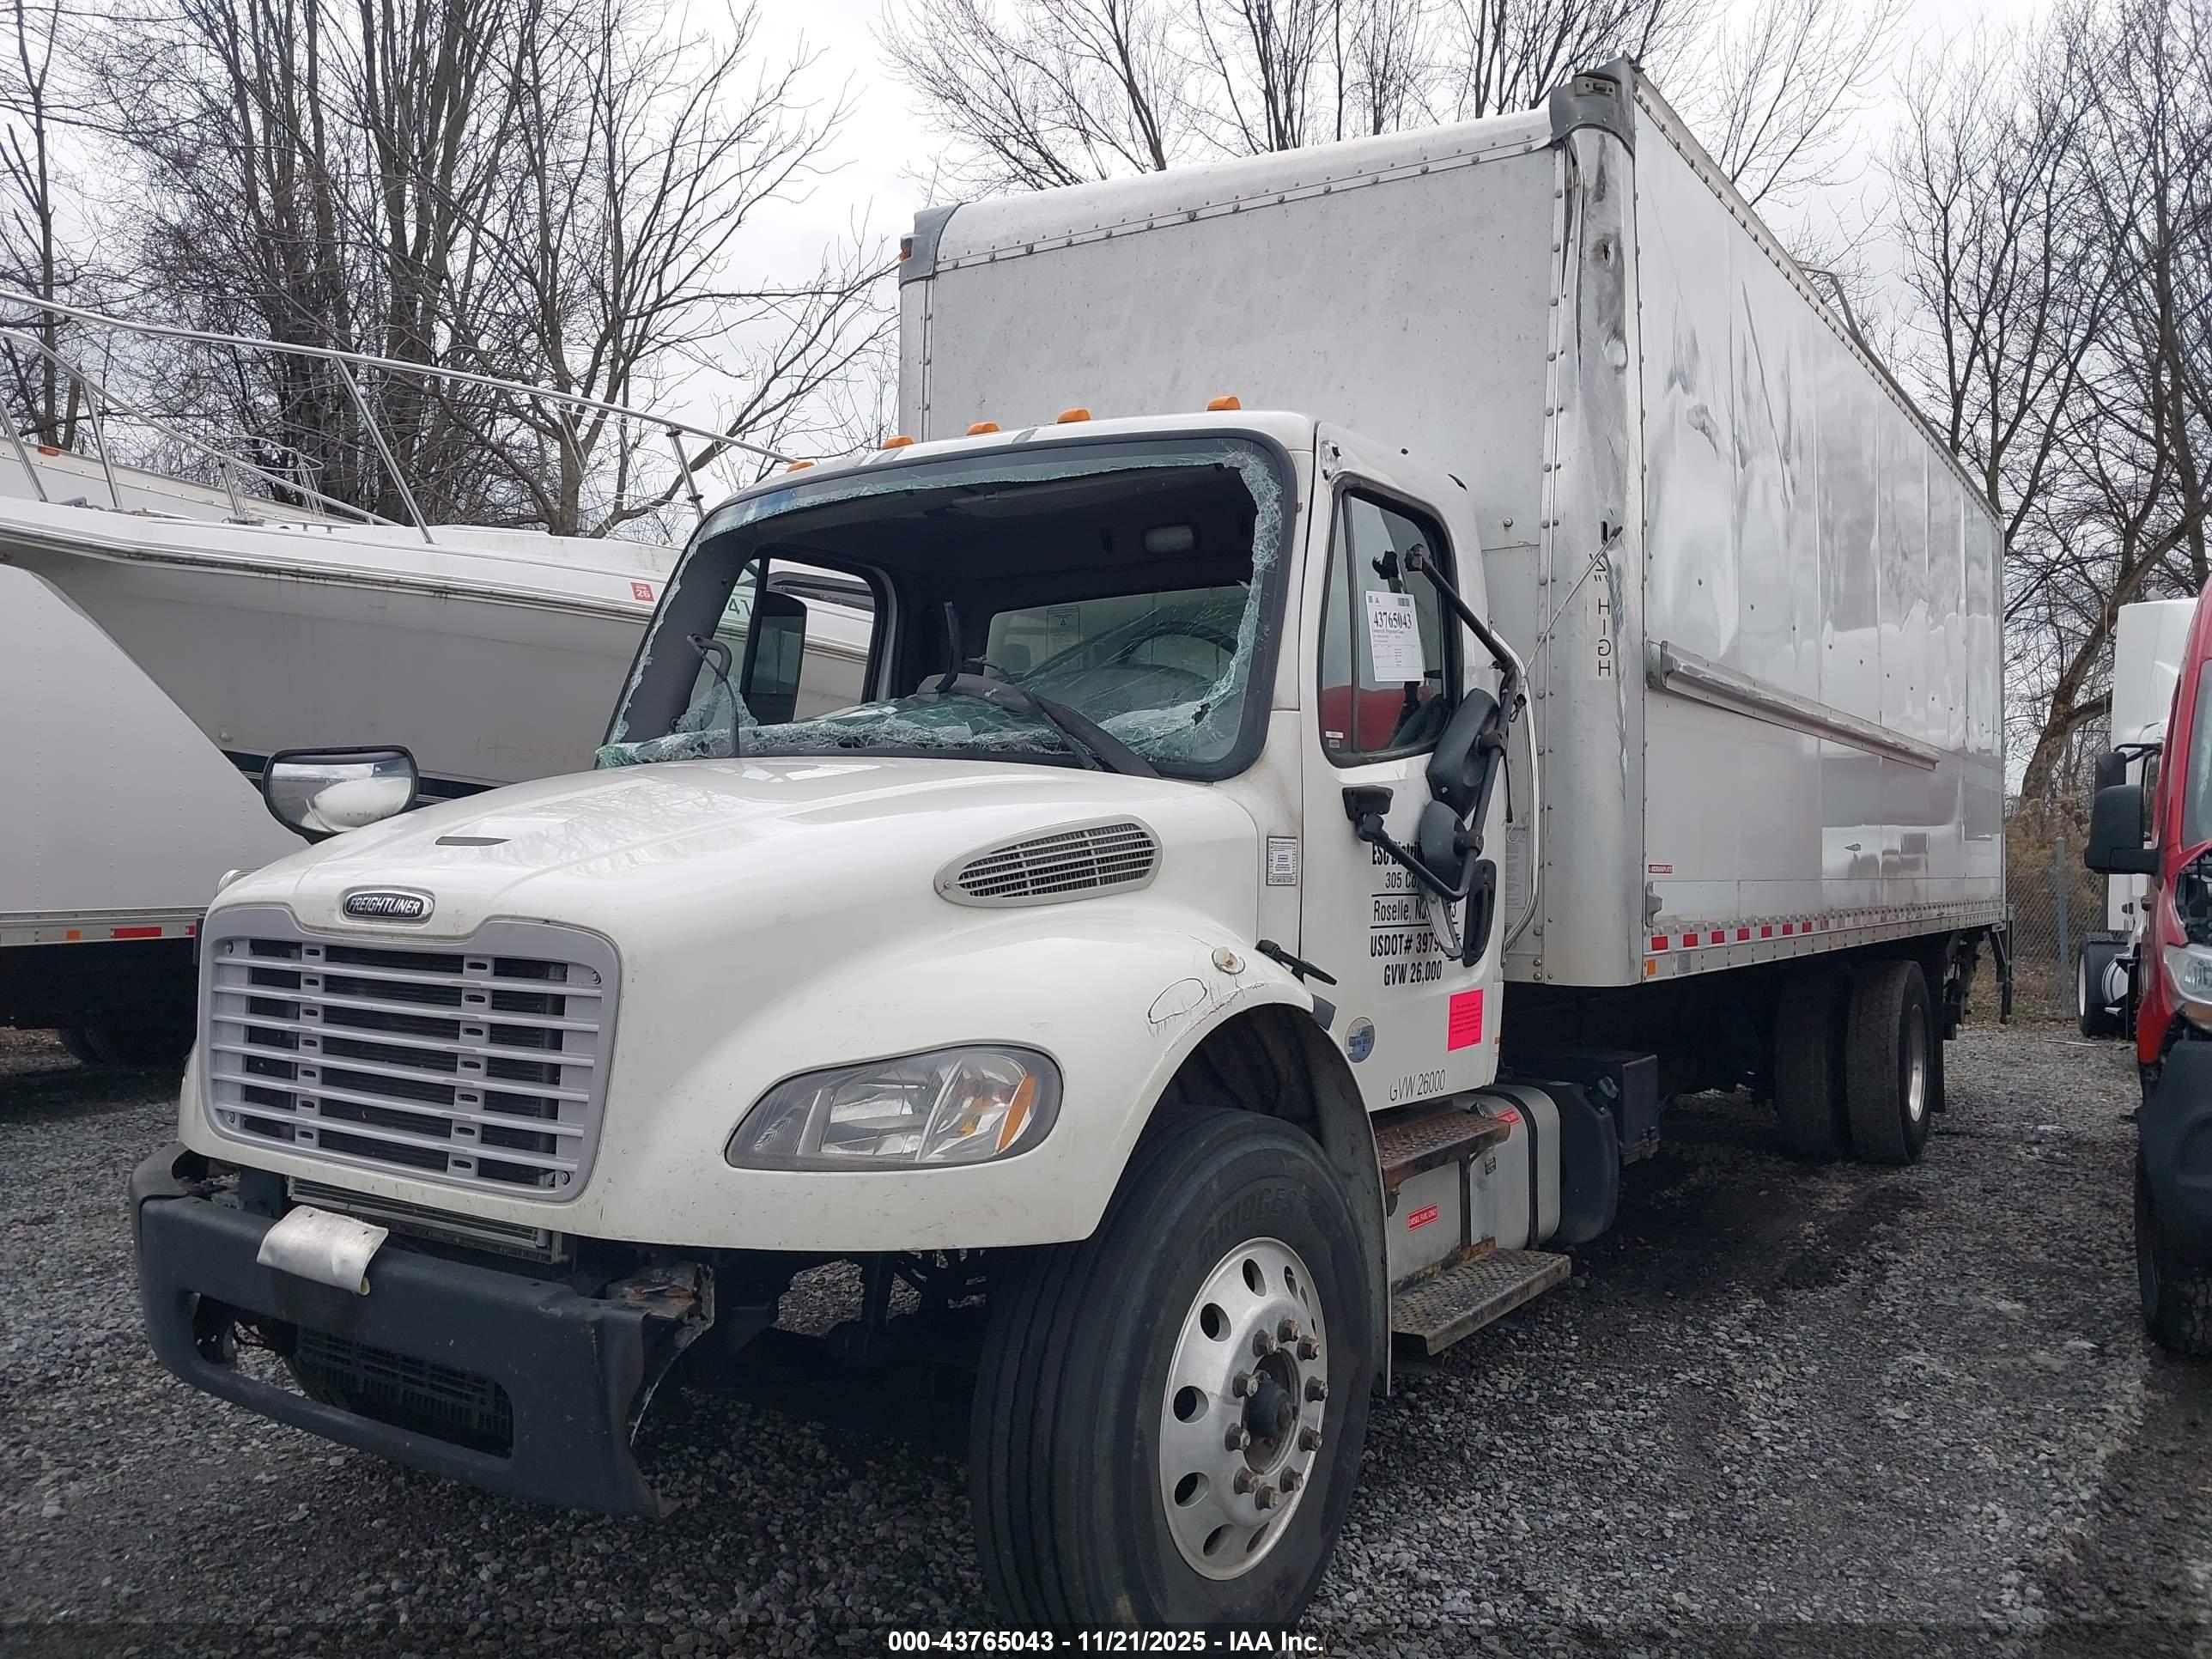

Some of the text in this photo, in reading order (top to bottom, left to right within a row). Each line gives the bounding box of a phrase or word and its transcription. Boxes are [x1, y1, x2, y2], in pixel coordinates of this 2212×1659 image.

[1374, 611, 1413, 629] 43765043
[1385, 872, 1418, 888] 305 Co
[347, 896, 421, 915] FREIGHTLINER
[1374, 899, 1412, 923] Roselle,
[1370, 933, 1413, 957] USDOT#
[1384, 959, 1443, 986] GVW 26,000
[1389, 1068, 1446, 1102] GVW 26000
